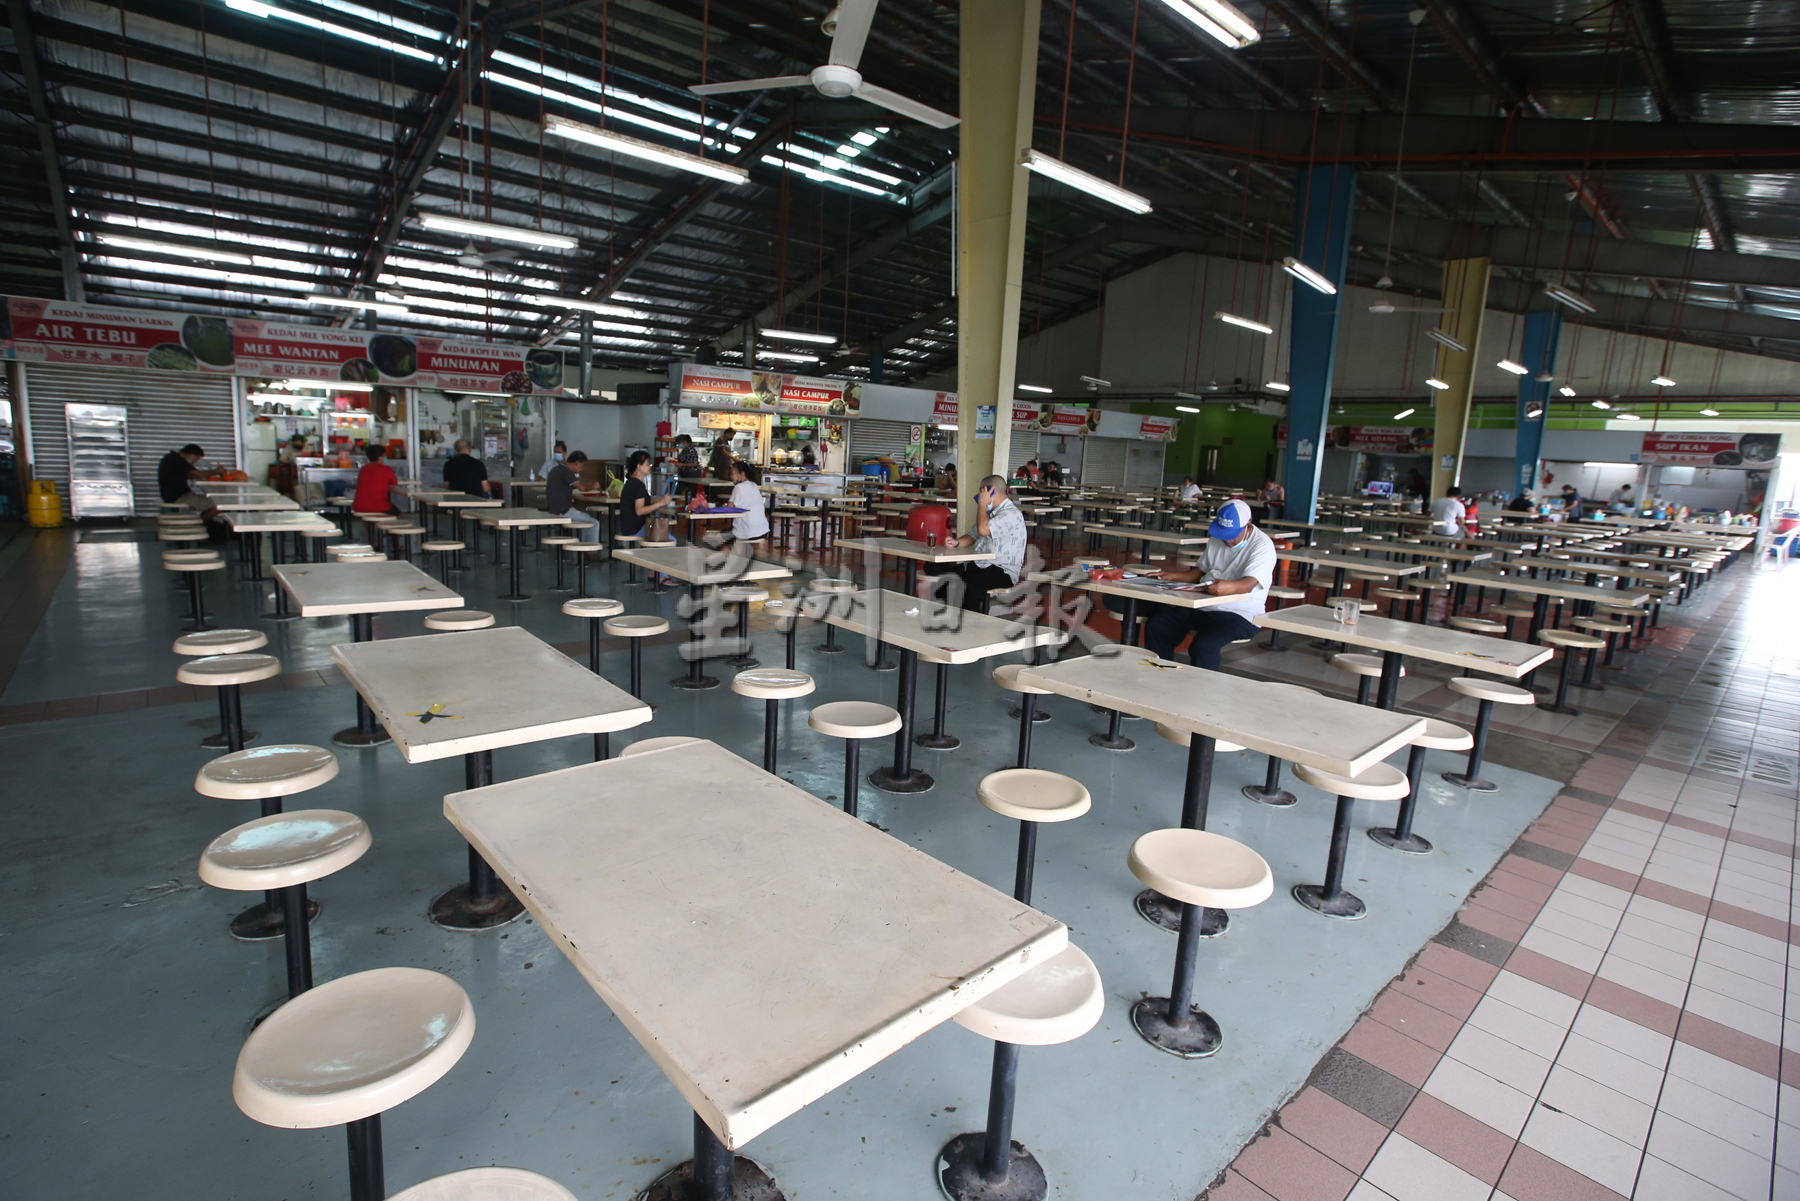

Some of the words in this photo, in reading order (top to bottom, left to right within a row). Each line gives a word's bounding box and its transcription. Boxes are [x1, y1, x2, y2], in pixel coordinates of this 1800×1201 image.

[51, 308, 84, 319] KEDAI
[85, 312, 137, 324] MINUMAN
[138, 318, 175, 327] LARKIN
[35, 323, 76, 340] AIR
[83, 327, 138, 345] TEBU
[266, 328, 298, 338] KEDAI
[299, 331, 319, 340] MEE
[320, 332, 348, 343] YONG
[348, 335, 366, 344] KEE
[243, 342, 274, 355] MEE
[277, 345, 340, 360] WANTAN
[442, 345, 469, 354] KEDAI
[470, 347, 490, 356] KOPI
[491, 349, 501, 357] EE
[502, 350, 522, 359] WAN
[430, 356, 501, 373] MINUMAN
[692, 379, 710, 387] NASI
[710, 380, 741, 390] CAMPUR
[783, 388, 800, 397] NASI
[801, 390, 830, 400] CAMPUR
[1016, 411, 1028, 419] SUP
[1655, 442, 1676, 451] SUP
[1678, 443, 1710, 452] IKAN
